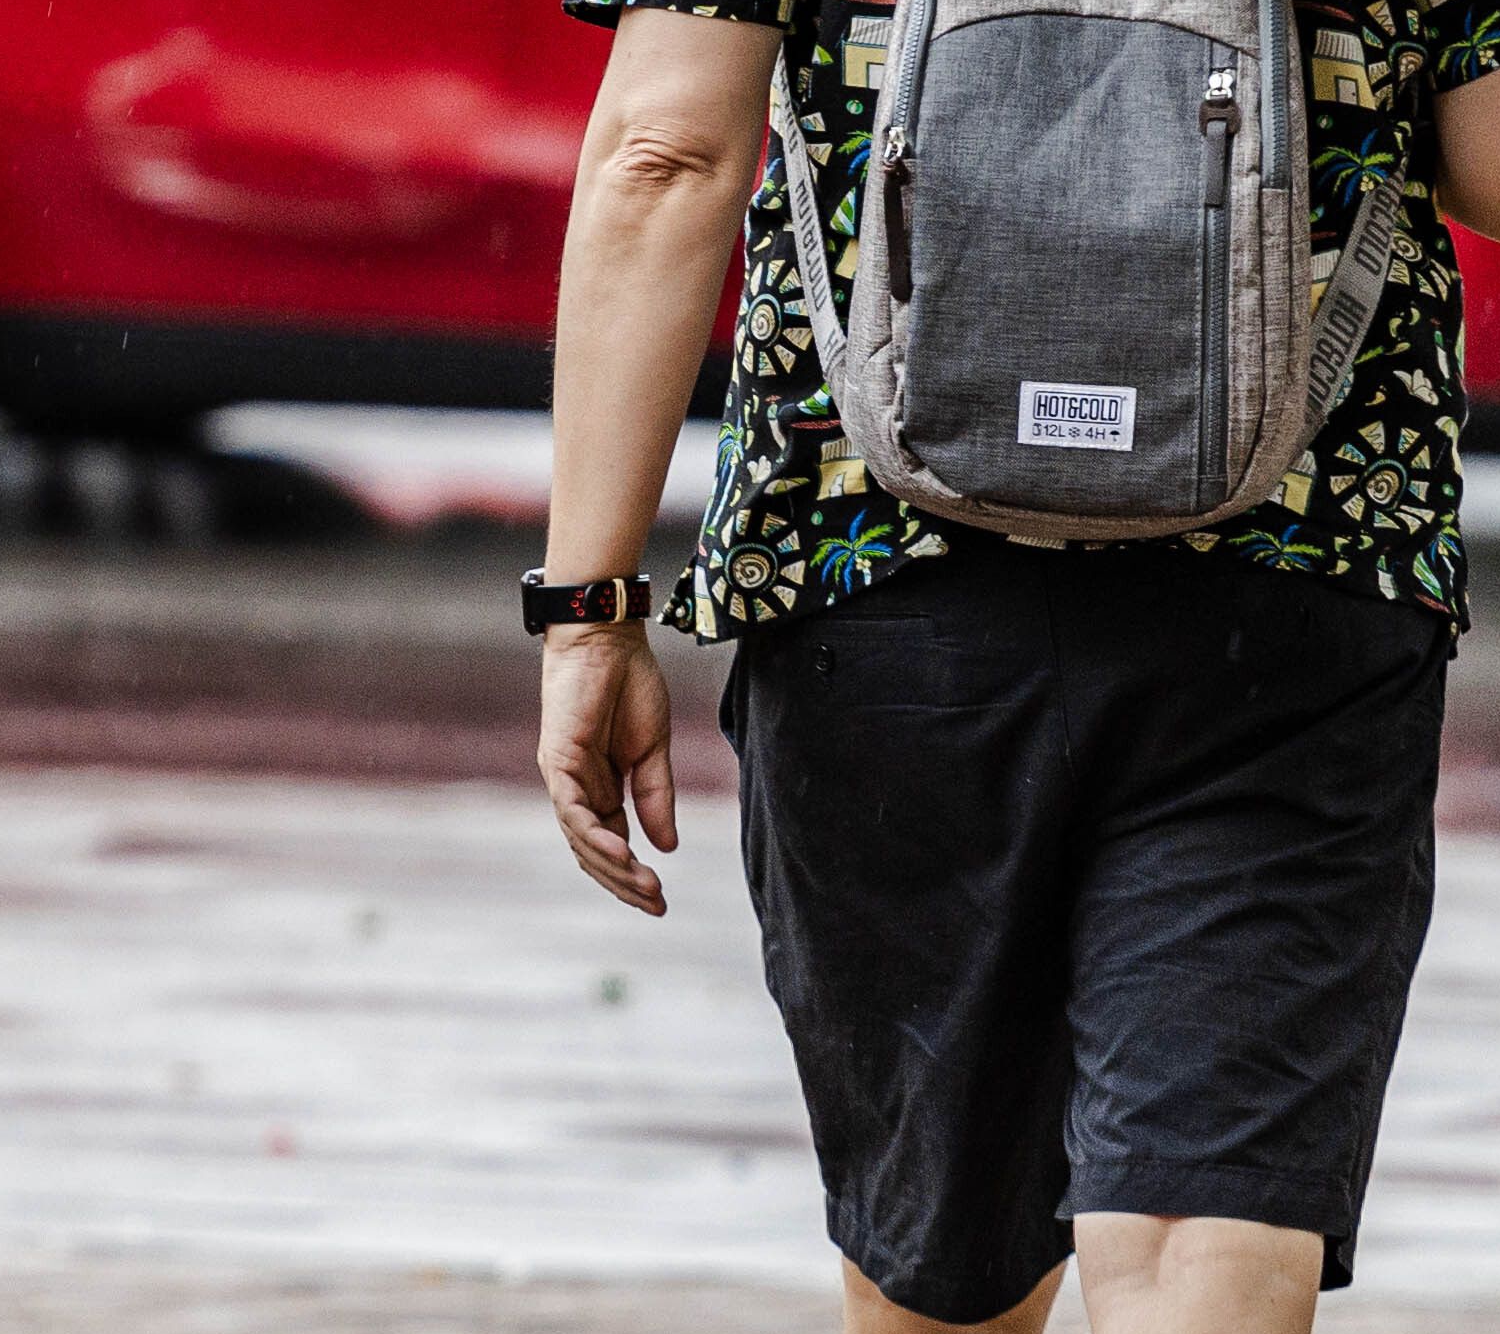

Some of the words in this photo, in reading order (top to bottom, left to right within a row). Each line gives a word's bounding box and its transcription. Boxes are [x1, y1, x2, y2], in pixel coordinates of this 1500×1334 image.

[1036, 394, 1119, 421] HOT&COLD
[1043, 423, 1066, 438] 12L
[1084, 426, 1106, 440] 4H
